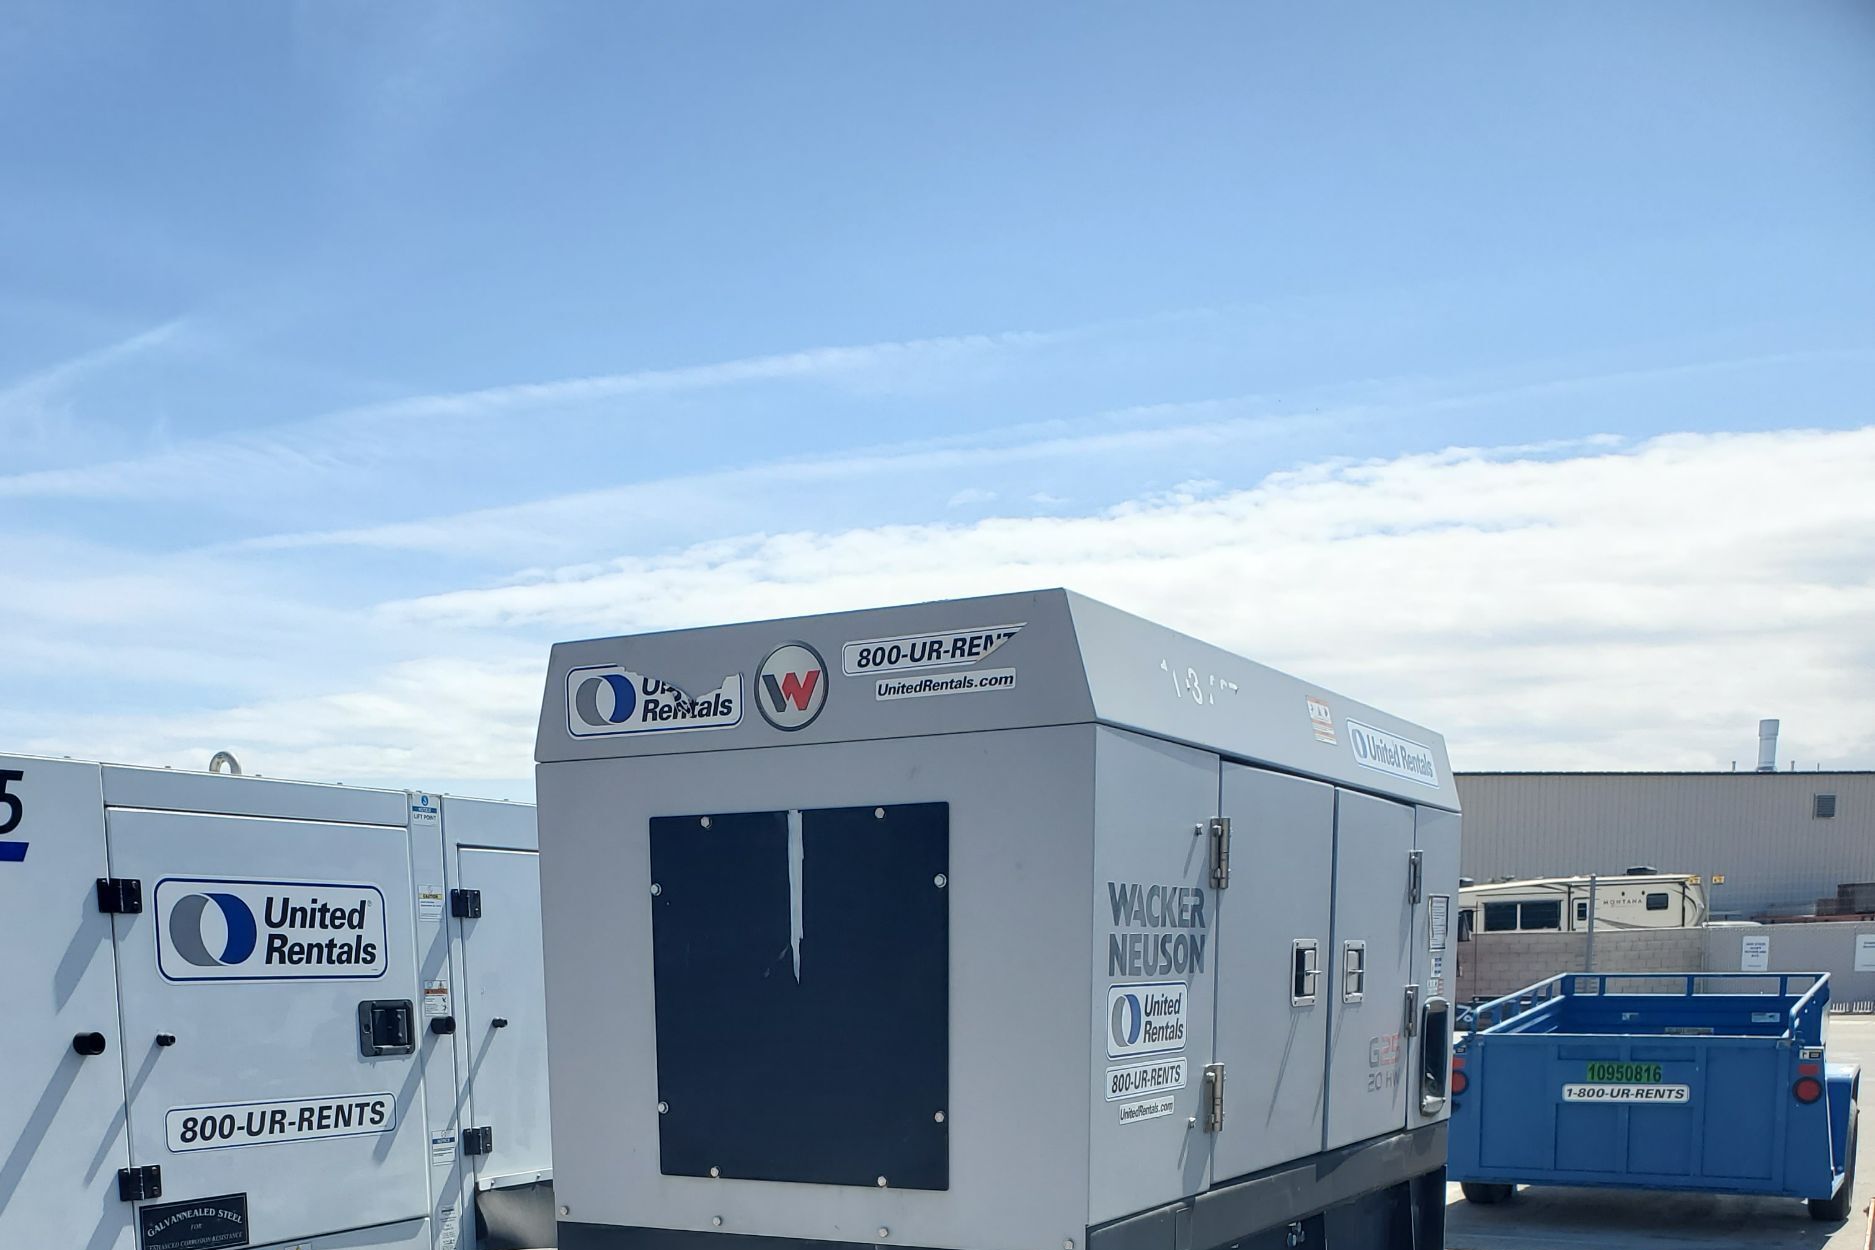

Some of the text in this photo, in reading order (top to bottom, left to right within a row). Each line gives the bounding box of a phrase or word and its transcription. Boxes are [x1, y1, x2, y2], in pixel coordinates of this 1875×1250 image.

[877, 674, 1014, 696] UnitedRentals.com
[1366, 734, 1434, 778] United Rentals
[264, 896, 367, 930] United
[1108, 881, 1206, 928] WACKER
[265, 933, 377, 966] Rentals
[1108, 933, 1206, 977] NEUSON
[1144, 992, 1183, 1018] United
[1142, 1018, 1184, 1044] Rentals
[1111, 1065, 1181, 1094] 800-UR-RENTS
[1588, 1063, 1662, 1082] 10950816
[1566, 1088, 1685, 1099] 1-800-UR-RENTS
[180, 1100, 385, 1143] 800-UR-RENTS
[1120, 1101, 1174, 1121] UnitedRentals.com
[147, 1208, 243, 1237] GALVANNEALED STEEL
